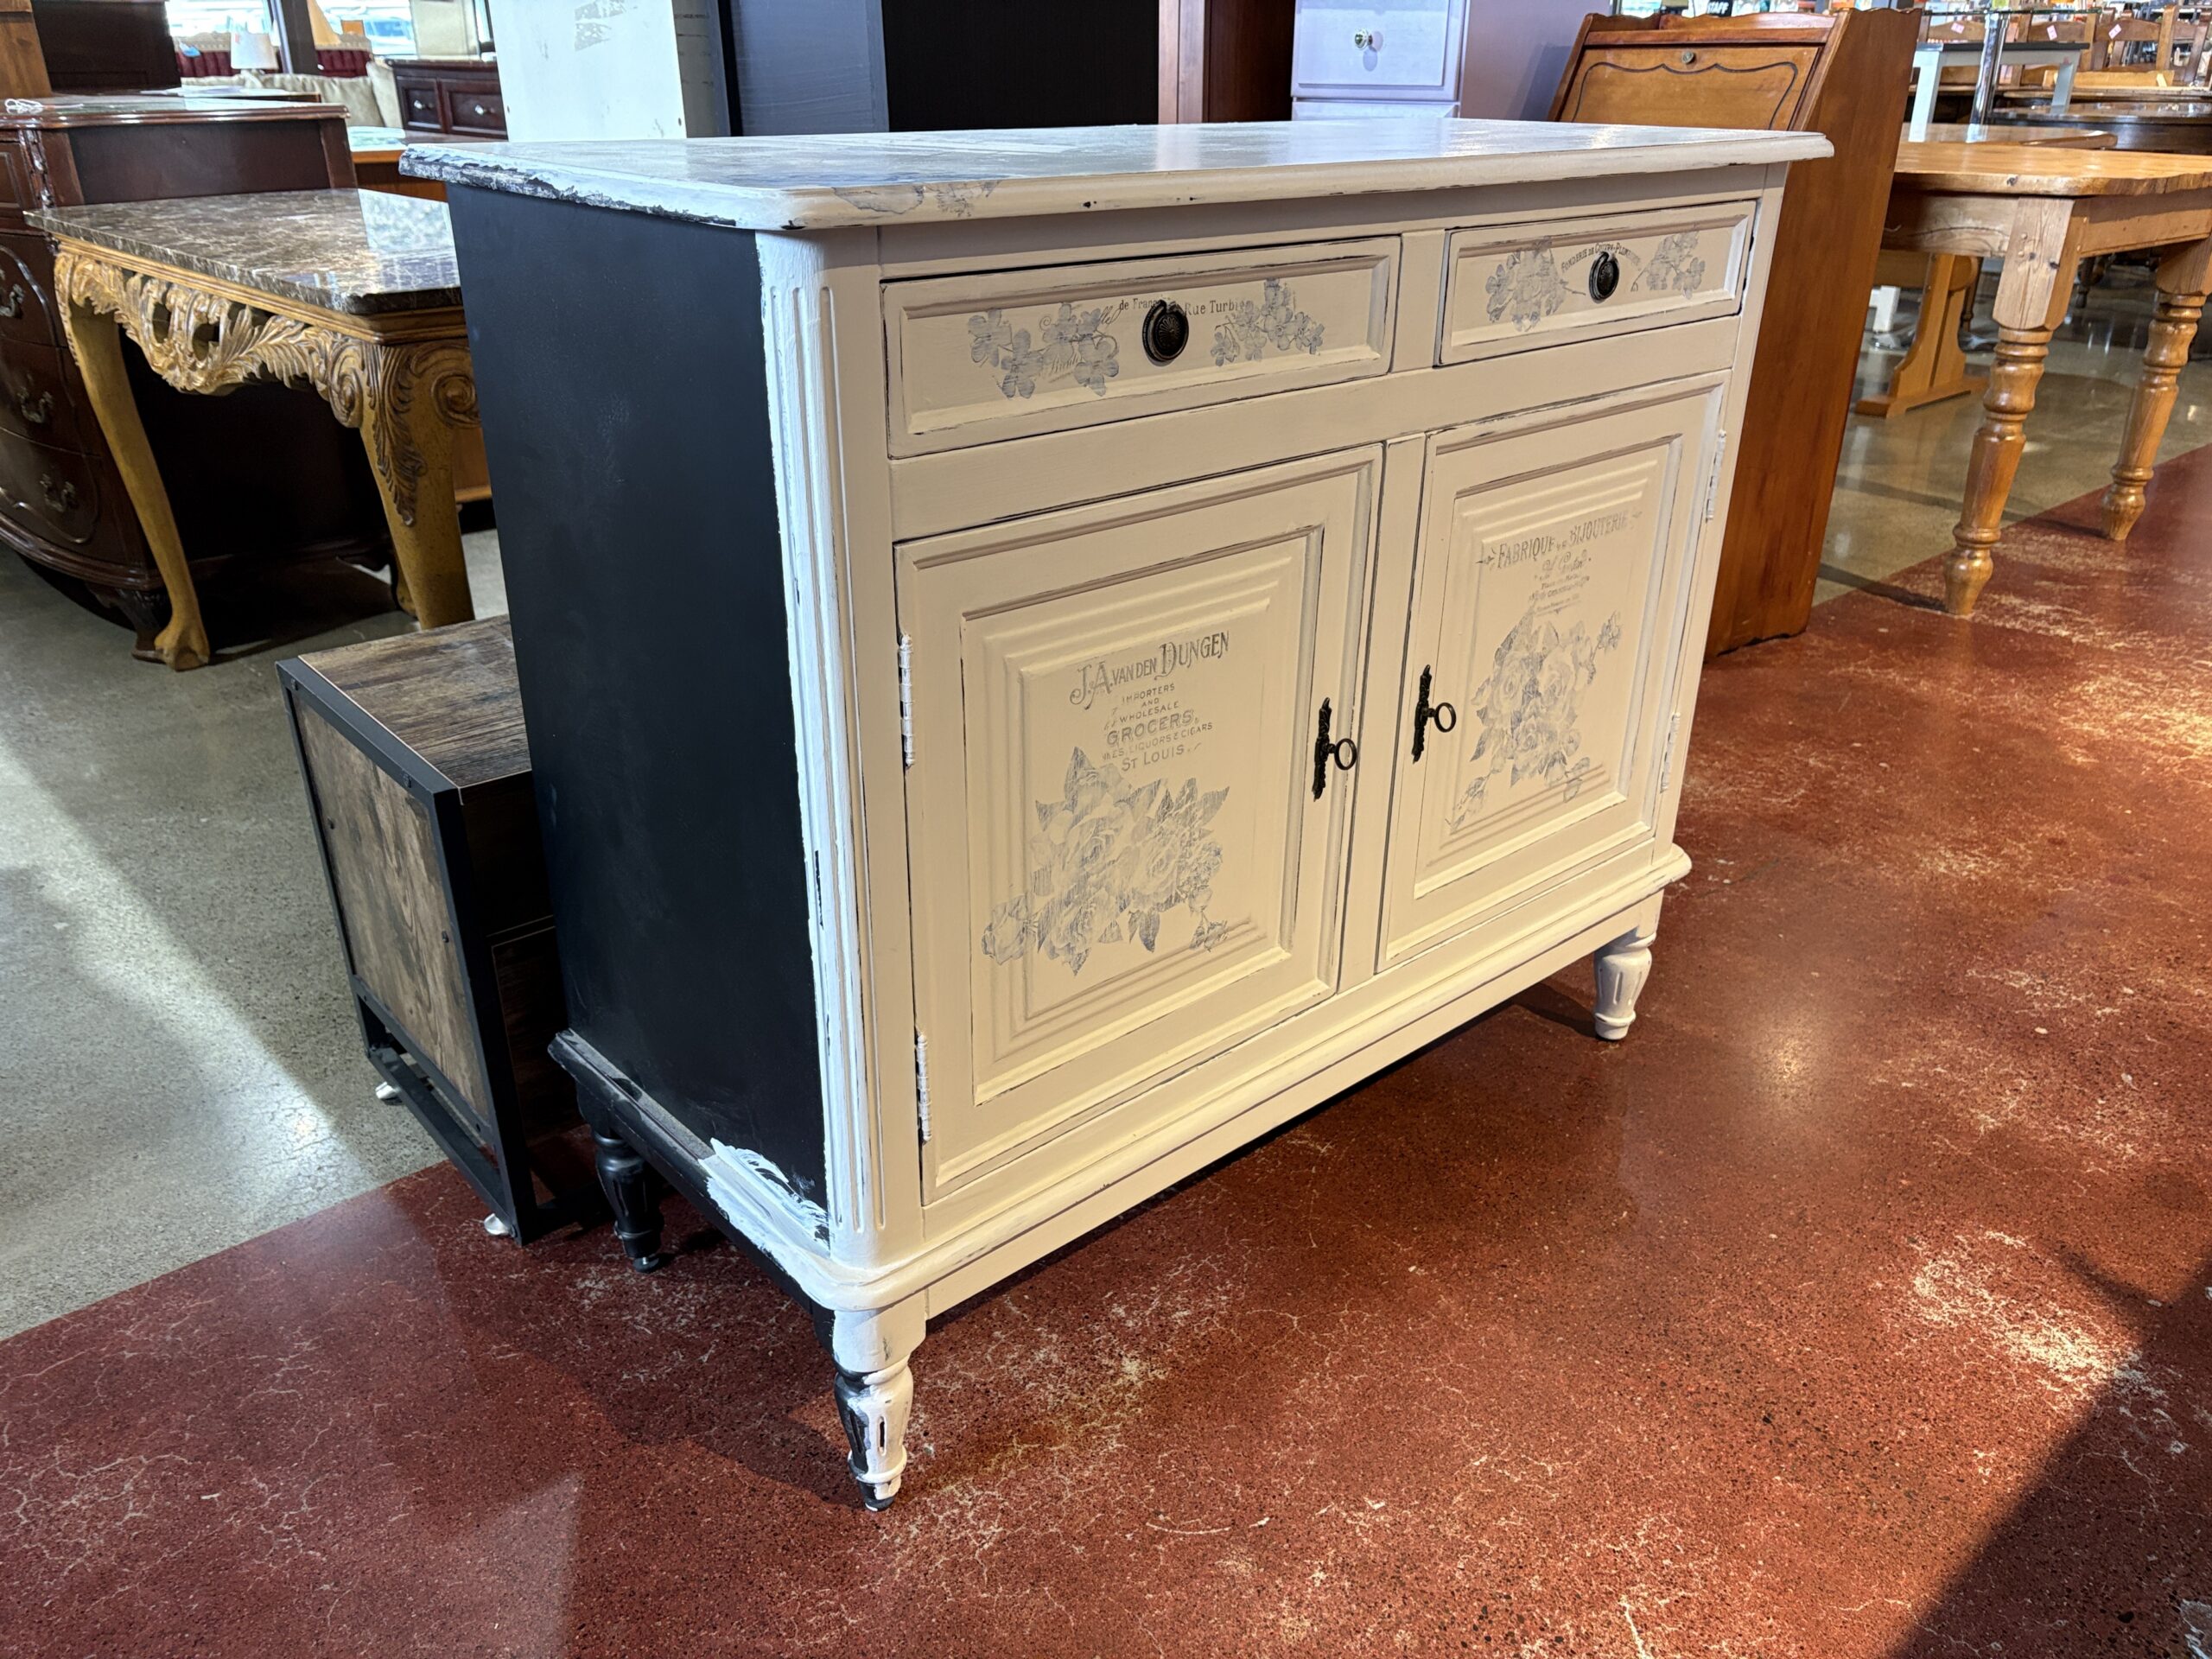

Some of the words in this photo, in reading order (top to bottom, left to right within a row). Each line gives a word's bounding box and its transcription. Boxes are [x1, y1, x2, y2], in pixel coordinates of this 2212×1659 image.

[1119, 299, 1128, 311] de
[1184, 302, 1206, 316] Rue
[1497, 536, 1555, 569] FABRIQUE
[1154, 631, 1230, 680] DUNGEN
[1122, 683, 1175, 705] IMPORTERS
[1141, 697, 1160, 708] AND
[1120, 701, 1179, 722] WHOLESALE
[1129, 734, 1172, 753] LIQUORS
[1181, 722, 1213, 738] CIGARS
